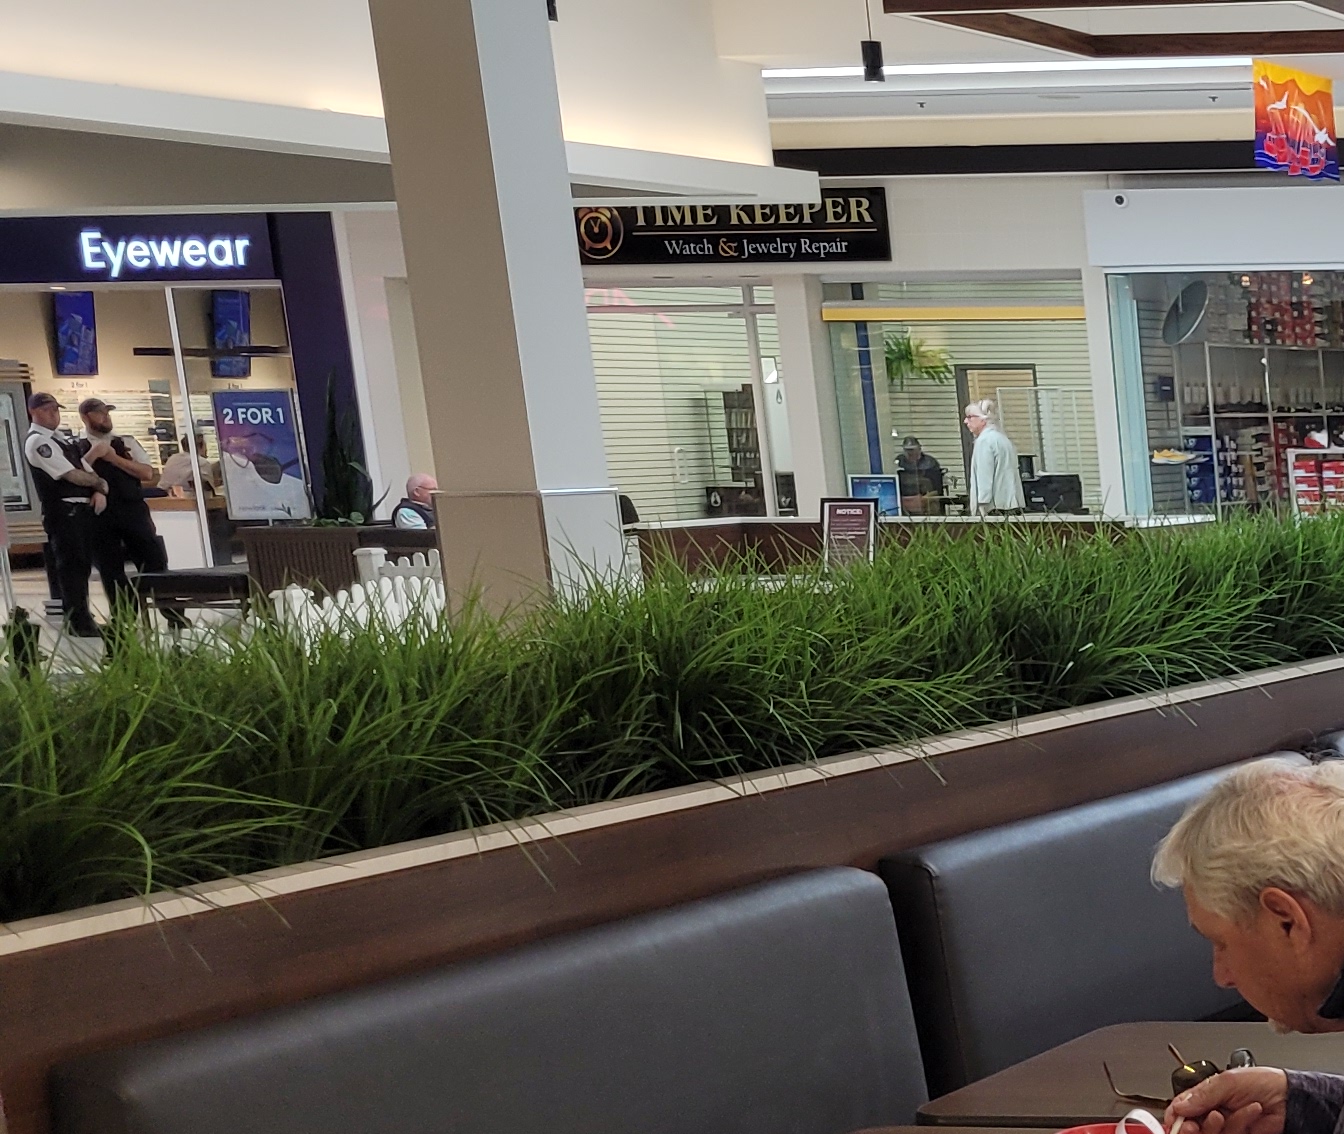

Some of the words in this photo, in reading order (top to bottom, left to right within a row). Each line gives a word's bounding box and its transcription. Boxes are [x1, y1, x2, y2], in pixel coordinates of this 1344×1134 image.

[631, 205, 718, 226] TIME
[728, 197, 875, 226] KEEPER
[79, 230, 251, 278] Eyewear
[664, 239, 714, 255] Watch
[718, 237, 739, 257] &
[741, 238, 797, 259] Jewelry
[800, 238, 848, 258] Repair
[222, 407, 235, 425] 2
[237, 407, 276, 425] FOR
[276, 407, 285, 424] 1
